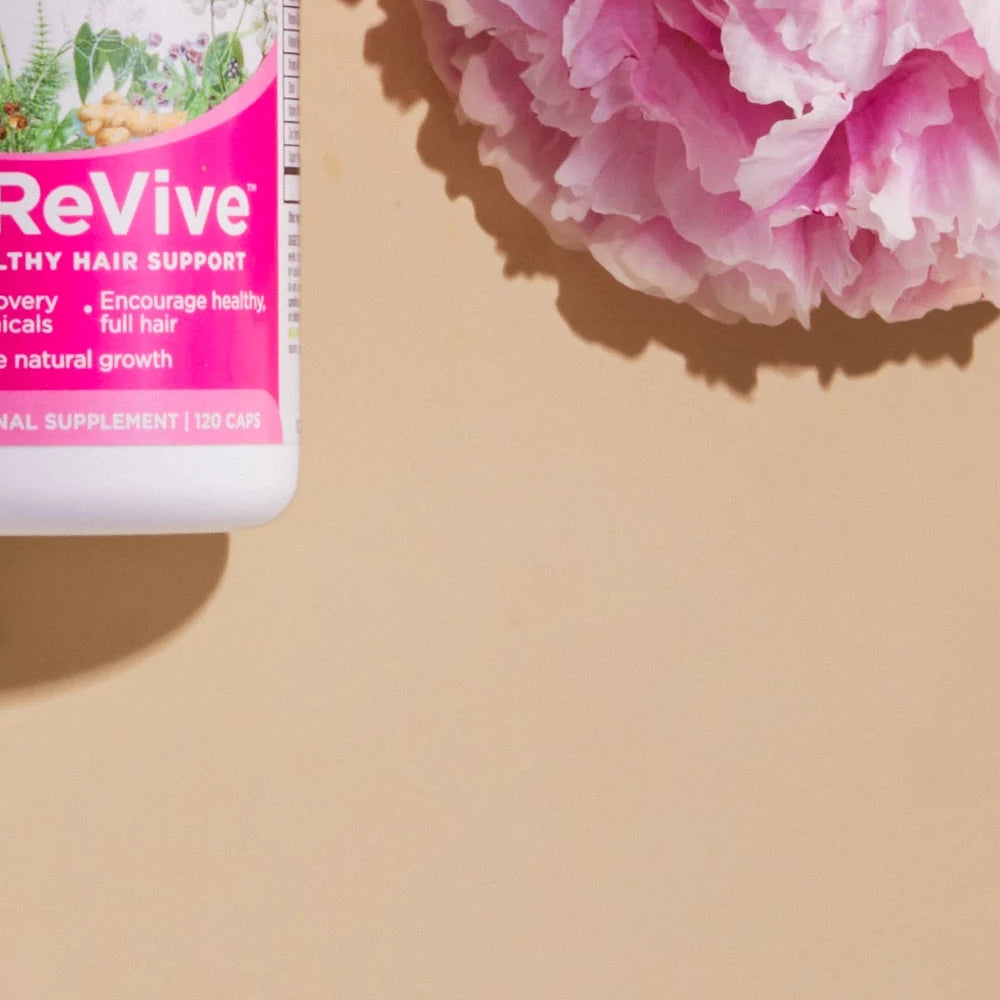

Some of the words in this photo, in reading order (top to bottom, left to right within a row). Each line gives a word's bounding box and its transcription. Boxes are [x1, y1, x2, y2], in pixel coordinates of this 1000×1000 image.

[73, 250, 140, 273] HAIR
[146, 250, 247, 272] SUPPORT
[100, 290, 208, 316] Encourage
[211, 289, 267, 314] healthy,
[99, 313, 134, 334] full
[139, 313, 179, 334] hair
[14, 348, 93, 370] natural
[98, 348, 173, 373] growth
[44, 411, 180, 433] SUPPLEMENT
[194, 411, 222, 430] 120
[225, 411, 262, 430] CAPS
